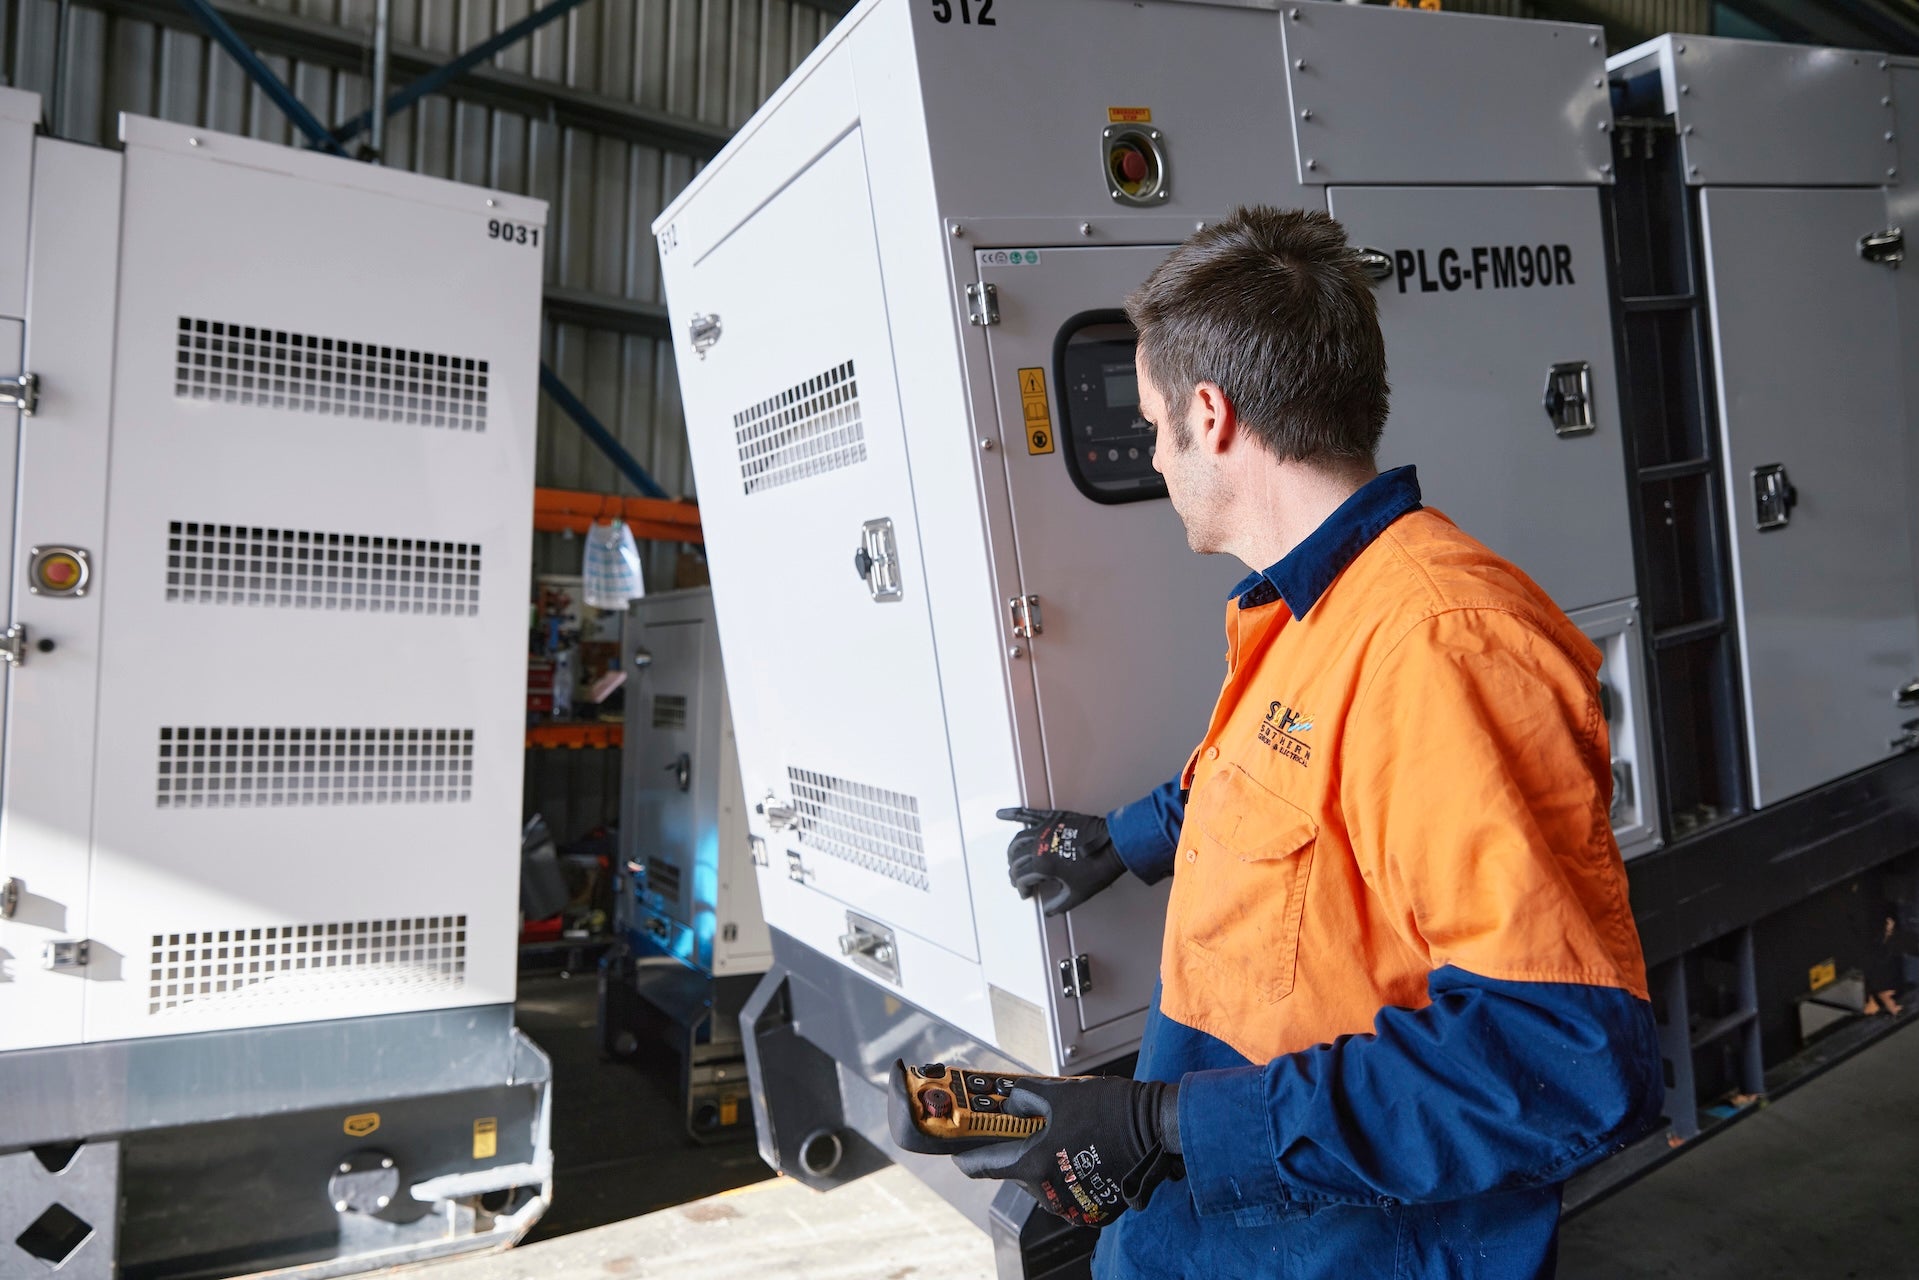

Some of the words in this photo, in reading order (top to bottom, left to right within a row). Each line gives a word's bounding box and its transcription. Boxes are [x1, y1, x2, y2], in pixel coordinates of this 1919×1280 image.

[932, 0, 996, 26] 512
[489, 219, 538, 248] 9031
[1395, 245, 1575, 293] PLG-FM90R
